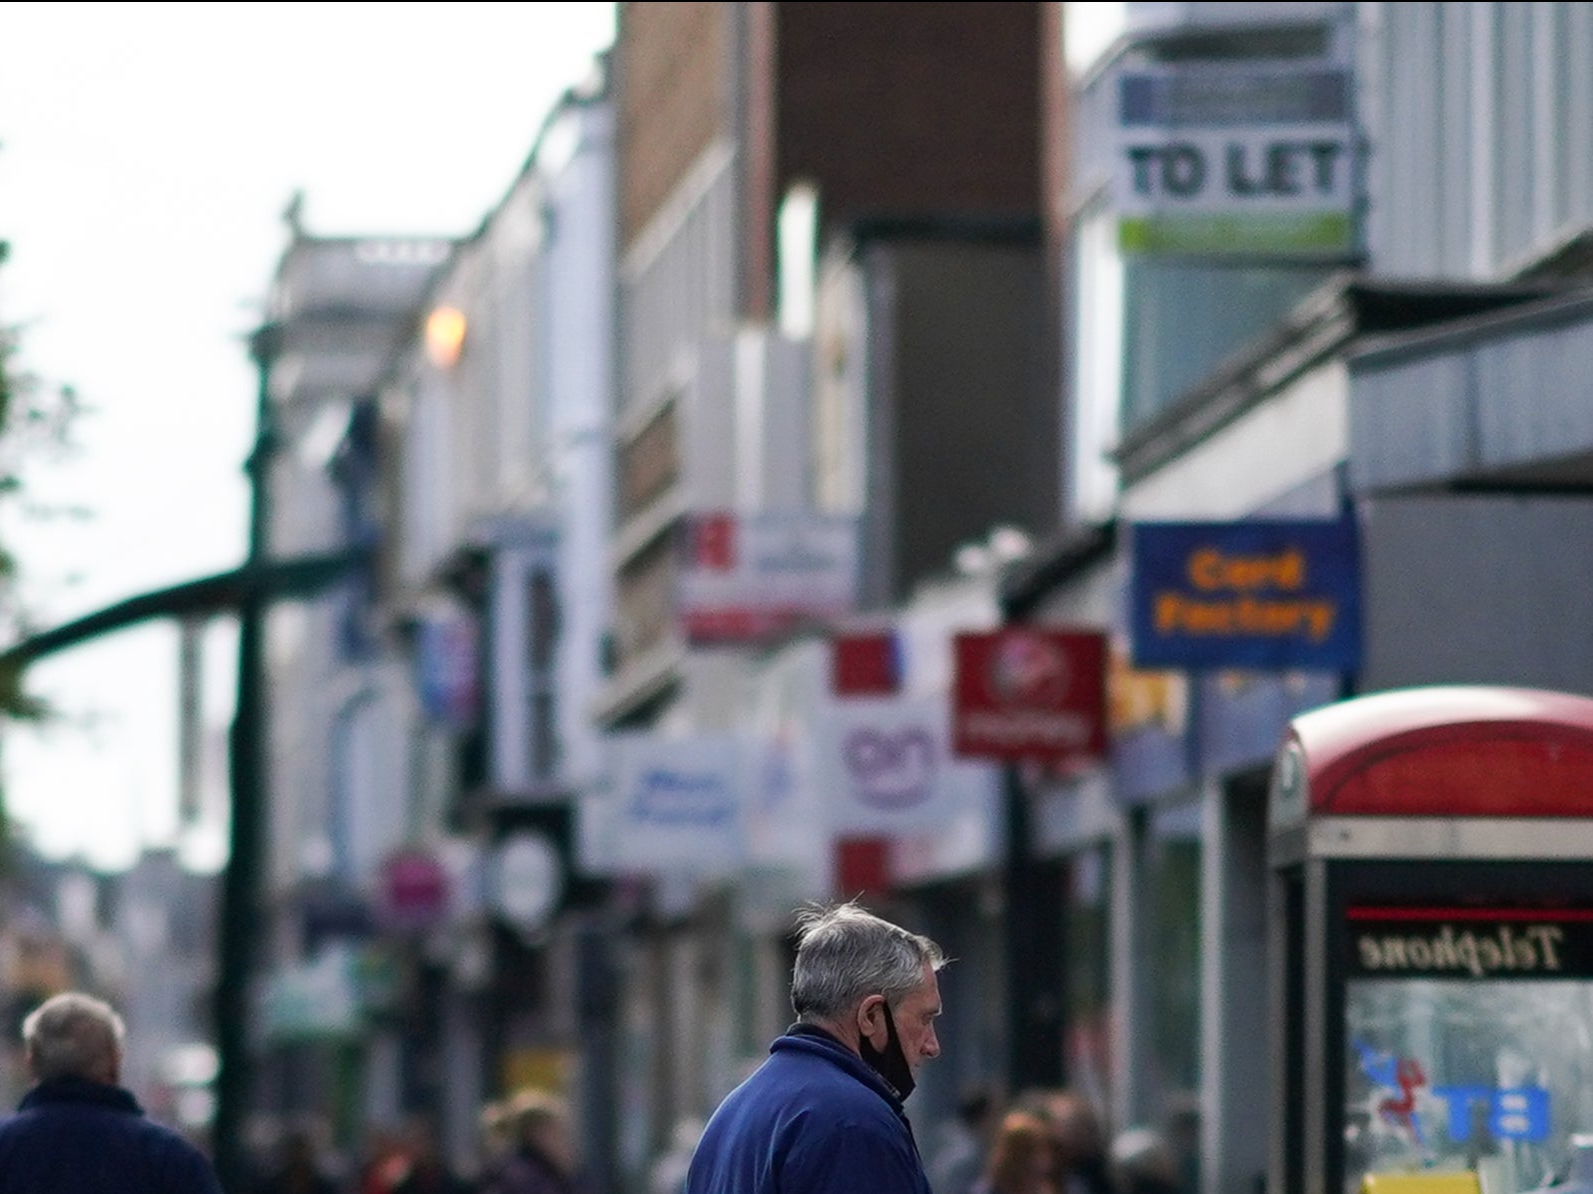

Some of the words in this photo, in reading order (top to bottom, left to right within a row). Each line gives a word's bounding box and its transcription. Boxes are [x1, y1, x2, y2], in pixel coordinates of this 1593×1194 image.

[1127, 142, 1205, 196] TO
[1226, 141, 1341, 196] LET
[1188, 549, 1303, 590] Card
[1154, 596, 1334, 640] Factory
